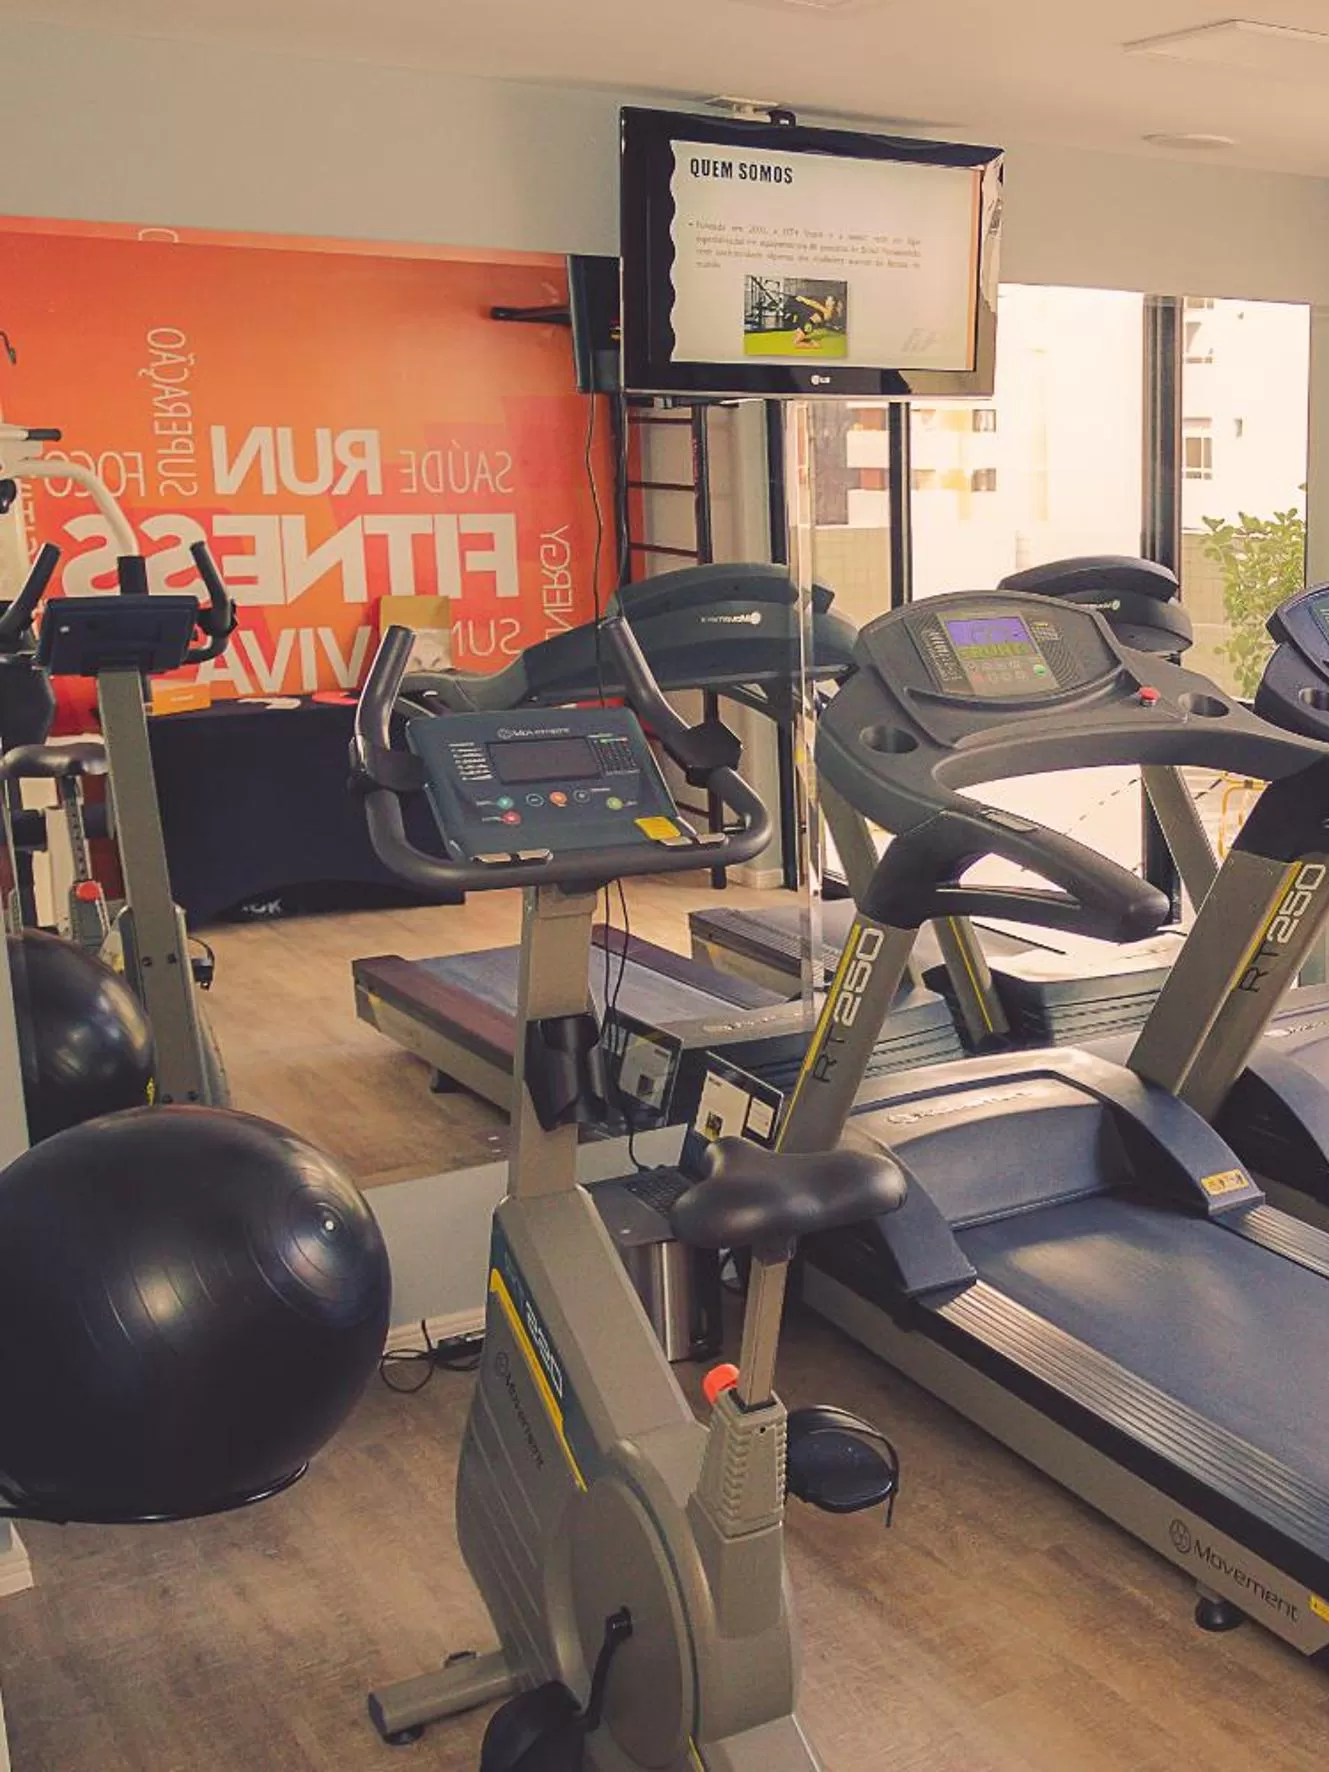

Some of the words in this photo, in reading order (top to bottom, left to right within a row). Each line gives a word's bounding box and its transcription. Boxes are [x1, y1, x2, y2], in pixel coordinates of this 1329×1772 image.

[690, 158, 733, 179] QUEM
[739, 162, 793, 184] SOMOS
[1193, 1538, 1300, 1625] Movement
